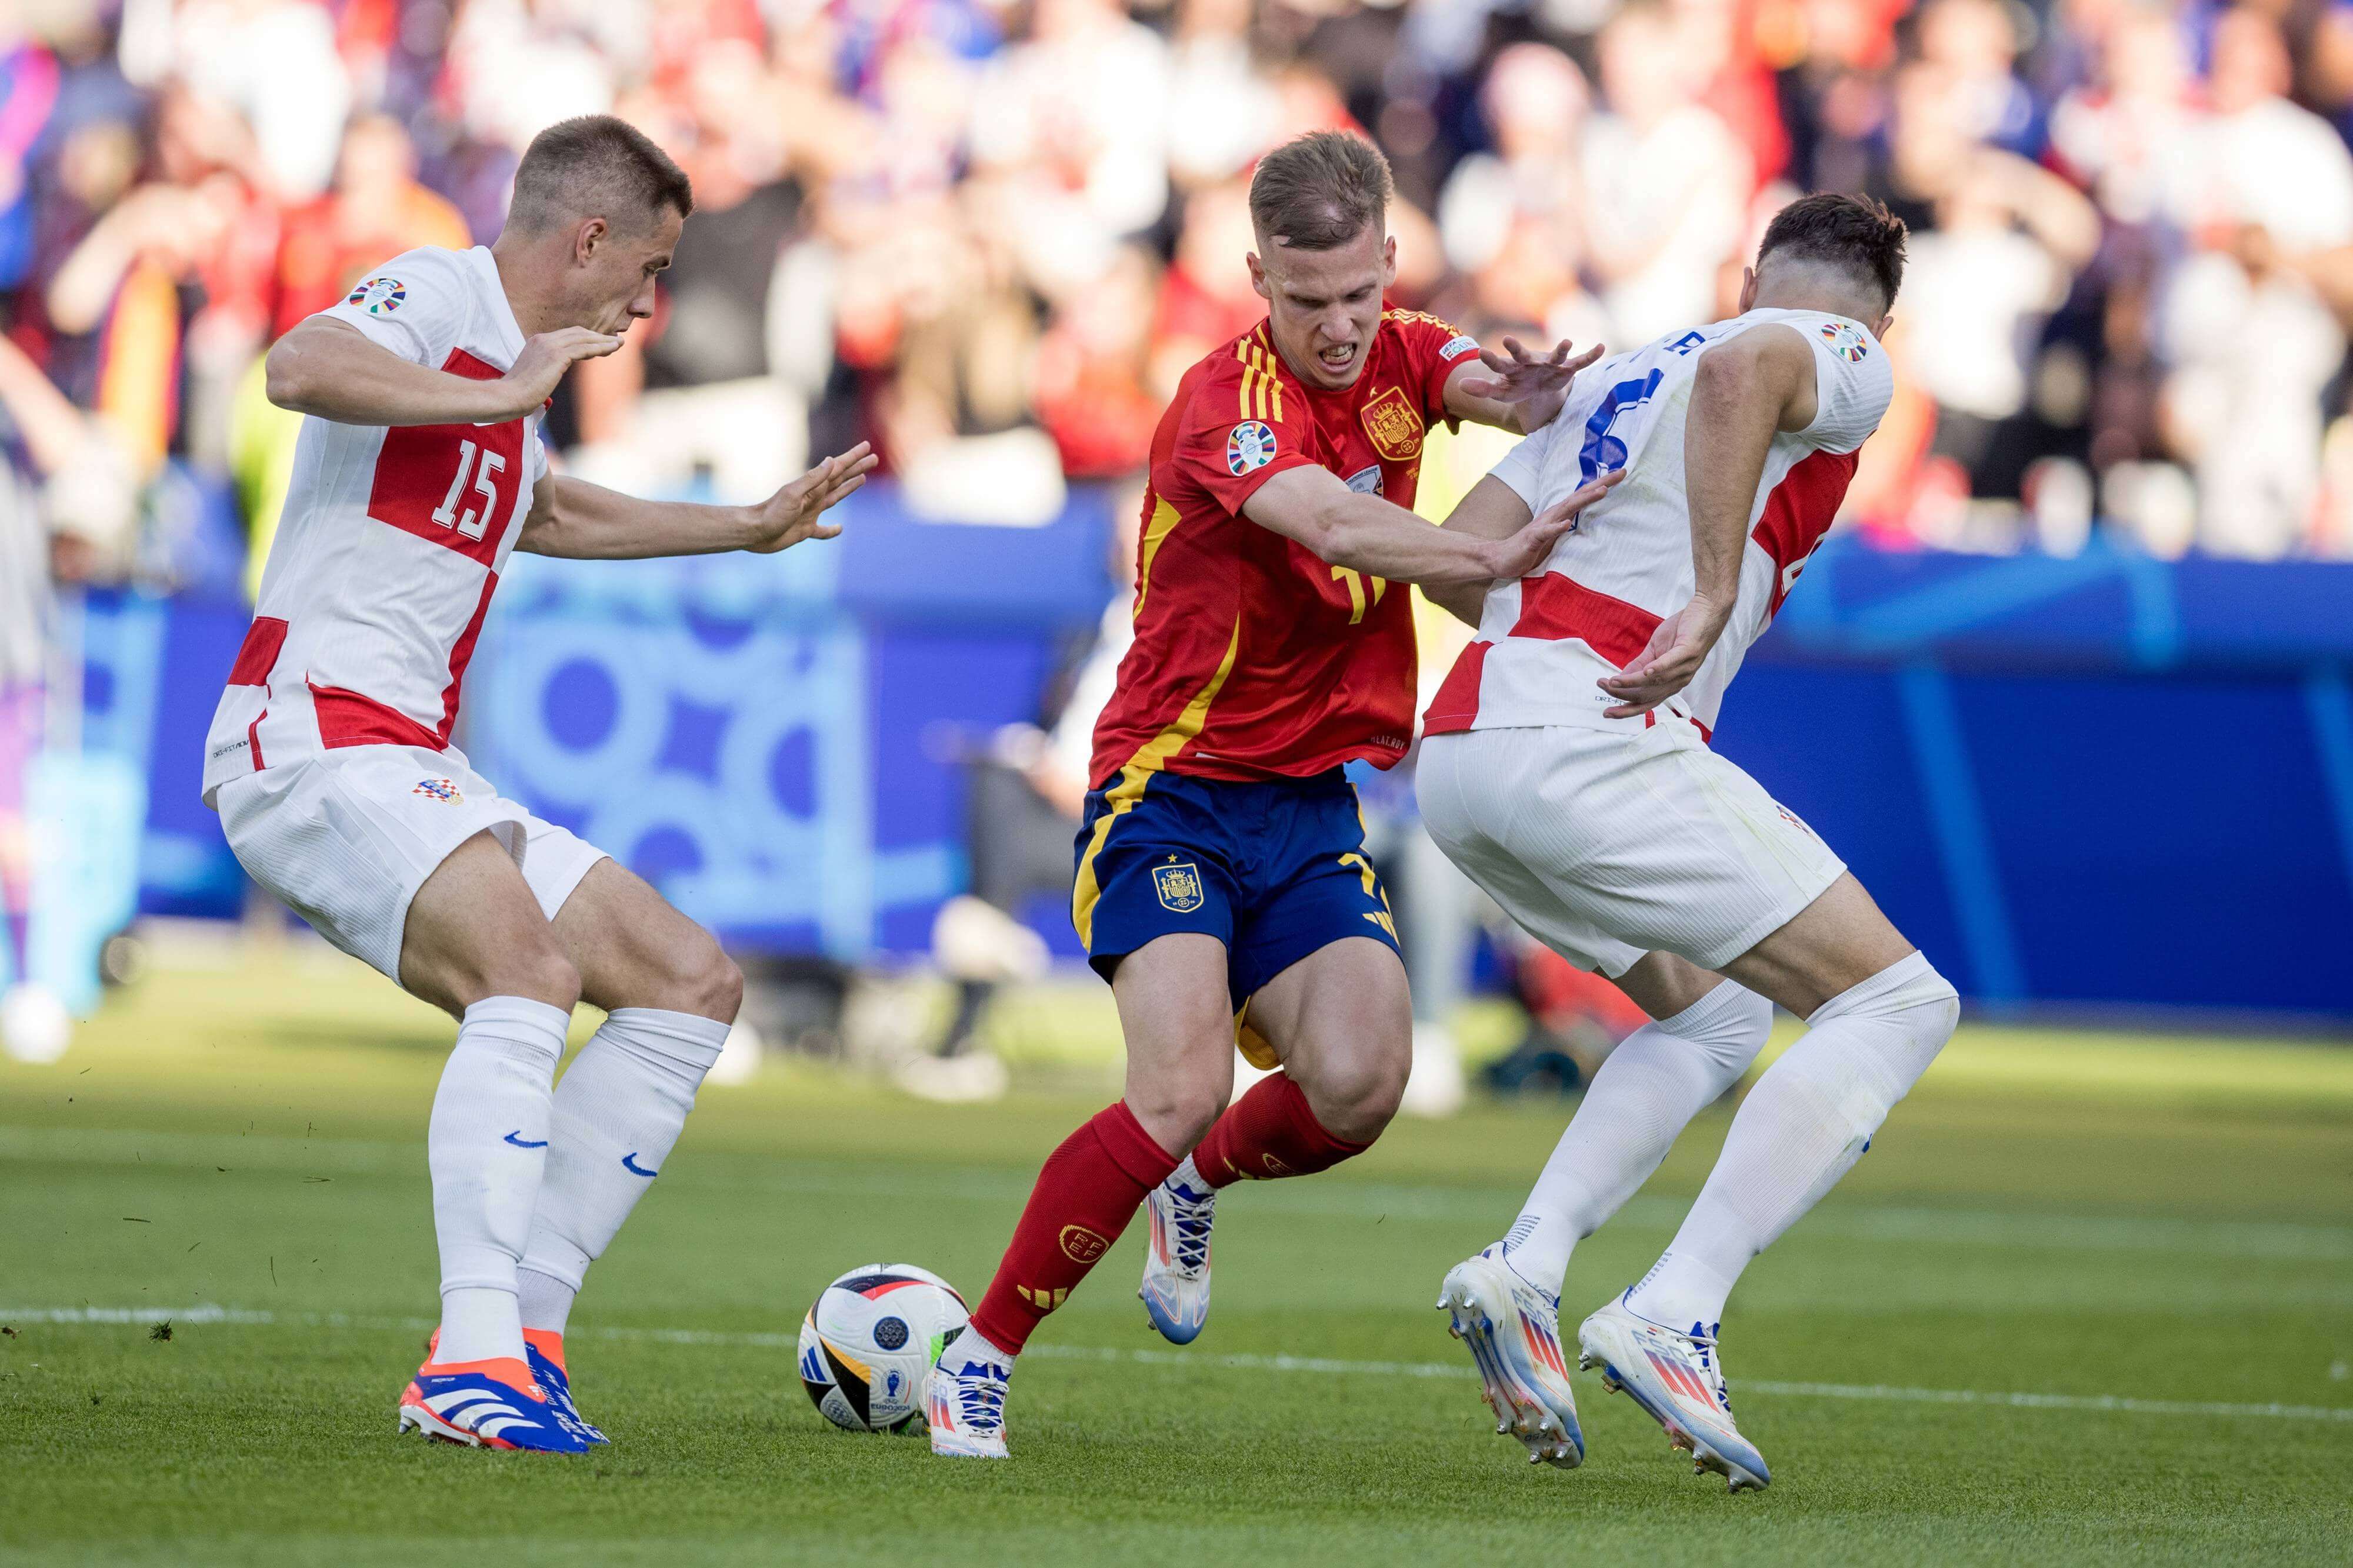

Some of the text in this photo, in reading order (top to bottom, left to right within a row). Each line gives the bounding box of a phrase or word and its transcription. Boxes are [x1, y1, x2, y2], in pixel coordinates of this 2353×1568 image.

[432, 439, 506, 542] 15
[1511, 1289, 1551, 1330] F50
[1631, 1330, 1689, 1365] F50
